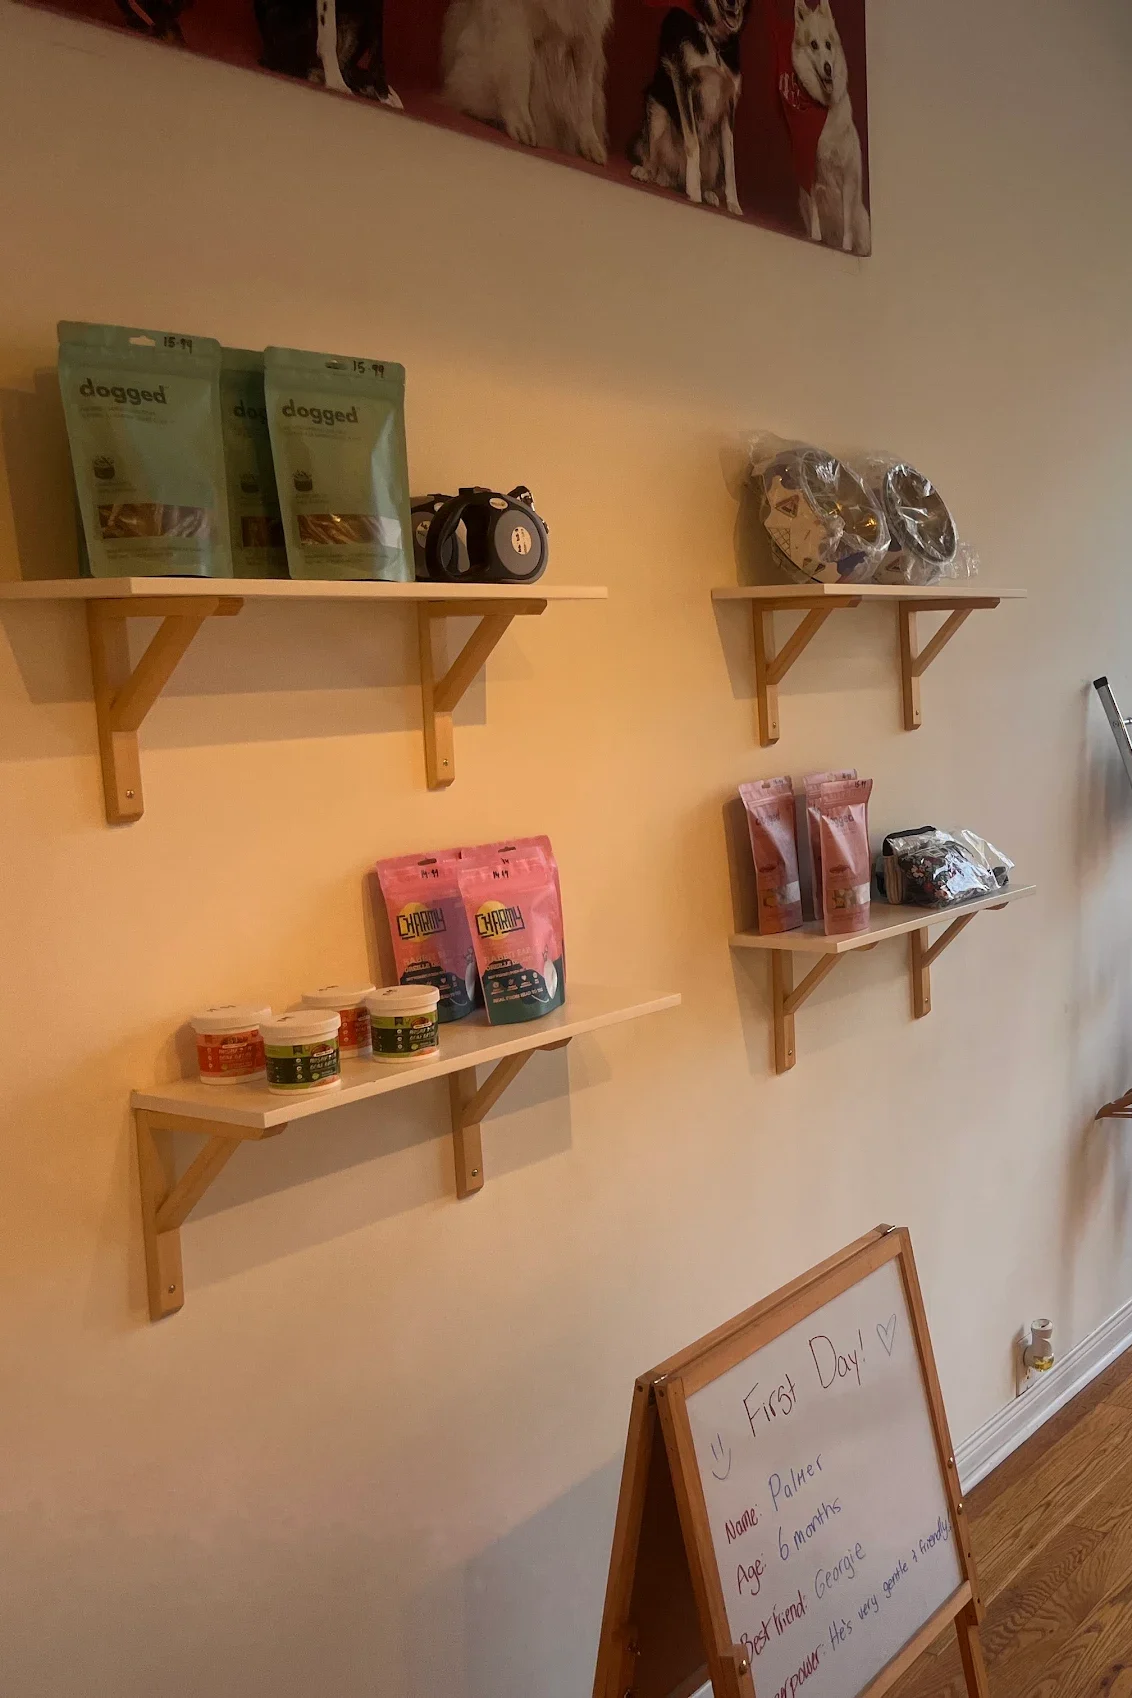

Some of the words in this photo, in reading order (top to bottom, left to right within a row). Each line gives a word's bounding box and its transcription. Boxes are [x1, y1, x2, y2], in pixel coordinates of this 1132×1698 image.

[79, 378, 167, 405] dogged
[282, 399, 358, 425] dogged
[743, 1373, 797, 1438] First
[808, 1329, 866, 1389] Day!
[724, 1503, 763, 1544] Name:
[736, 1552, 767, 1596] Age:
[778, 1526, 790, 1561] 6
[793, 1498, 842, 1550] months
[740, 1616, 772, 1664] Best
[814, 1542, 867, 1599] Georgie
[828, 1618, 853, 1651] He's
[857, 1593, 879, 1621] very
[882, 1559, 909, 1599] gentle
